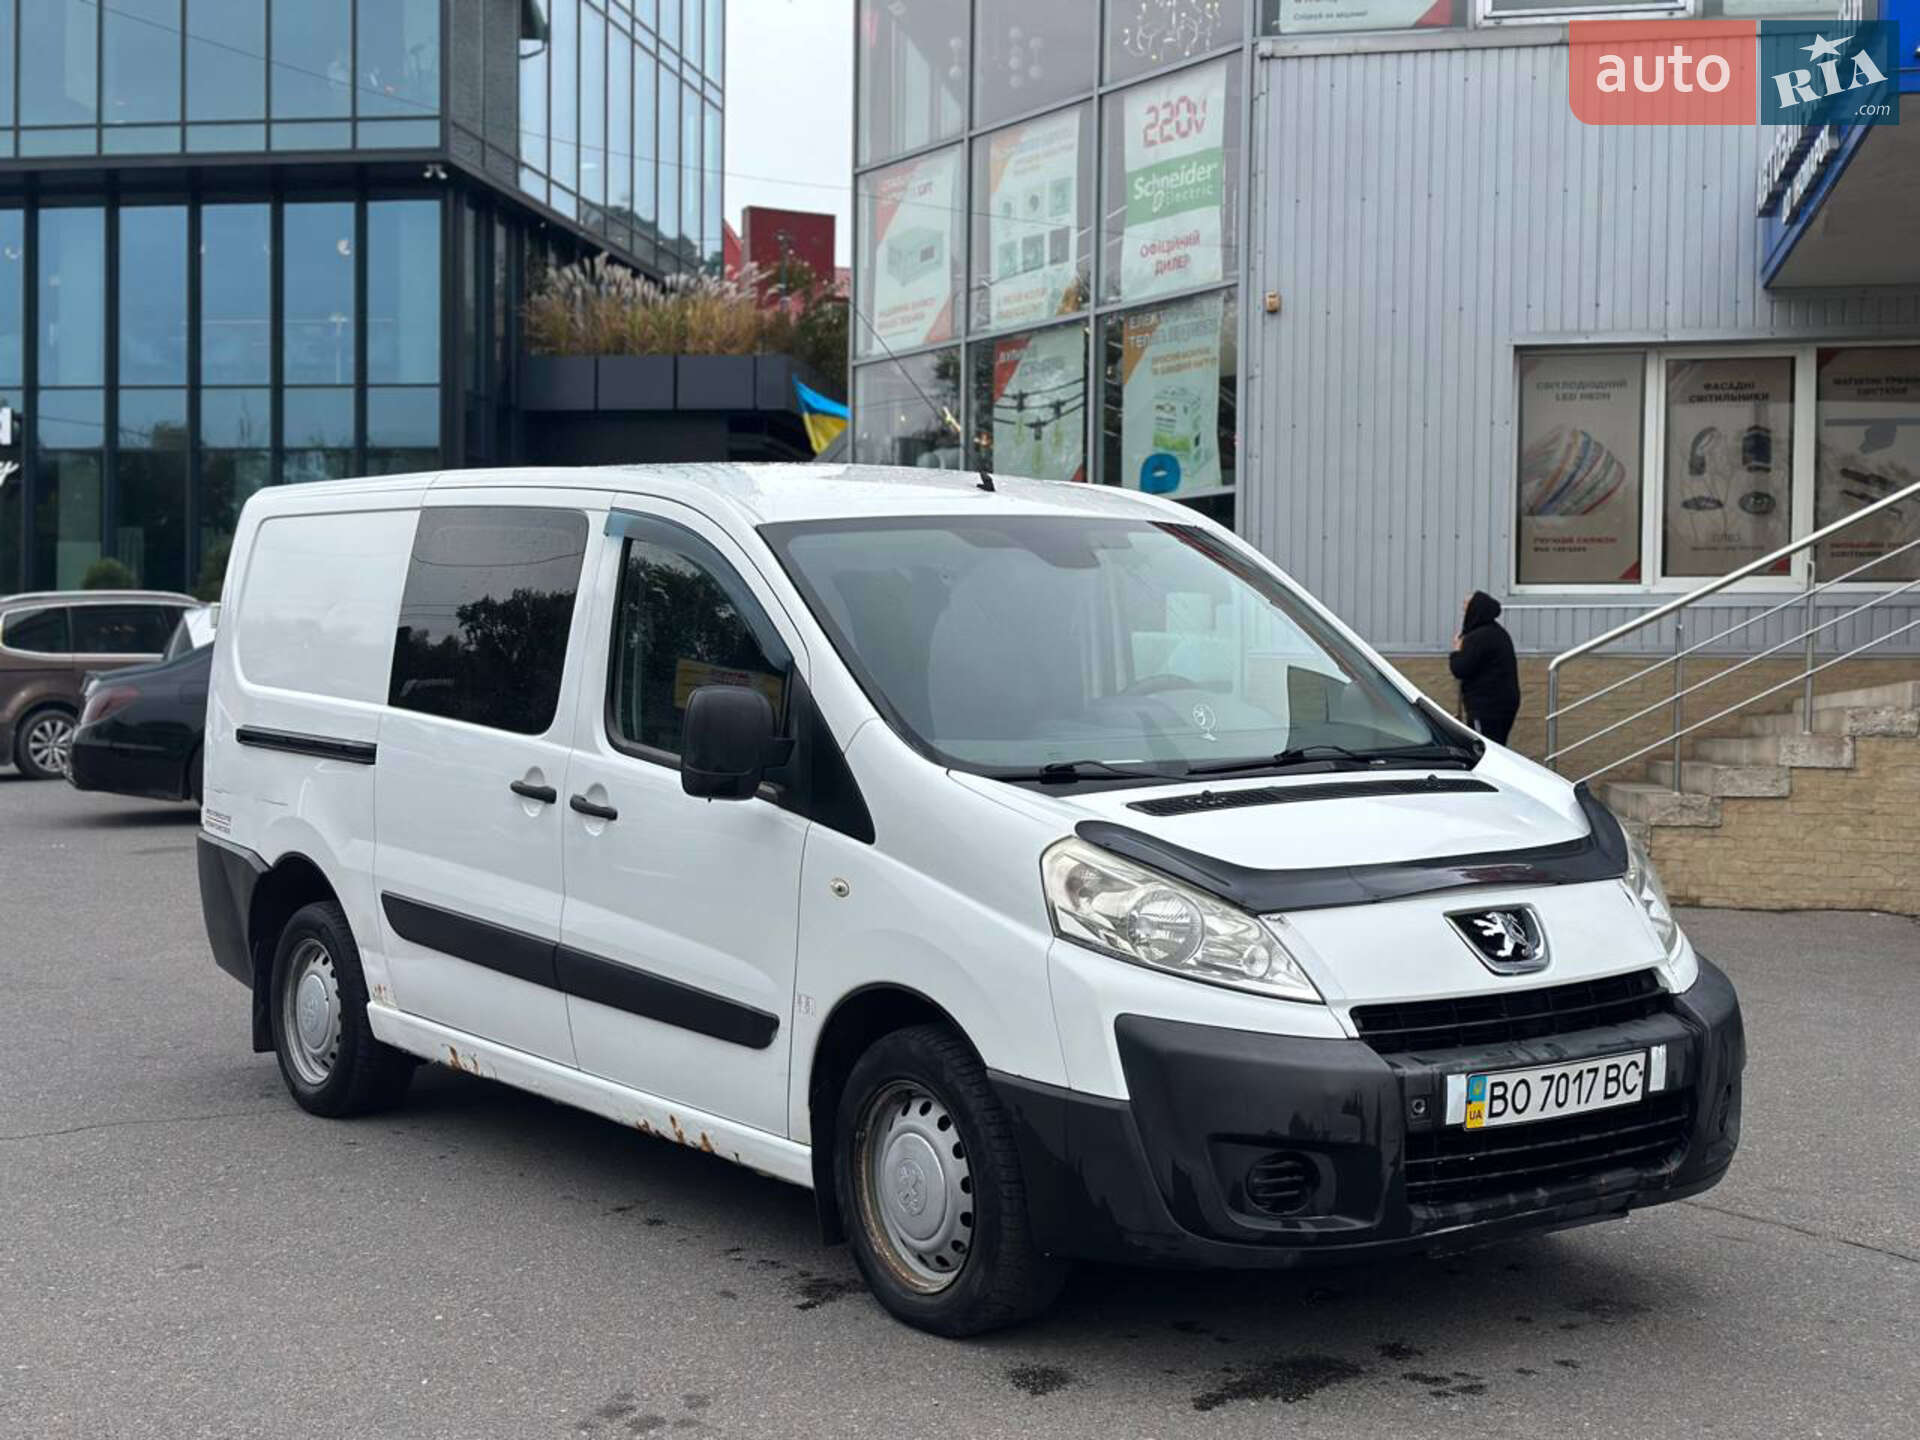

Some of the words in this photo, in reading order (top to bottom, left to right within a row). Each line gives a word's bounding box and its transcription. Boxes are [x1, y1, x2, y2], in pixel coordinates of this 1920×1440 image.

[1143, 96, 1207, 147] 220V
[1133, 161, 1219, 200] Schneider
[1488, 1078, 1532, 1119] BO
[1540, 1066, 1600, 1112] 7017
[1603, 1060, 1641, 1101] BC
[1469, 1110, 1483, 1121] UA
